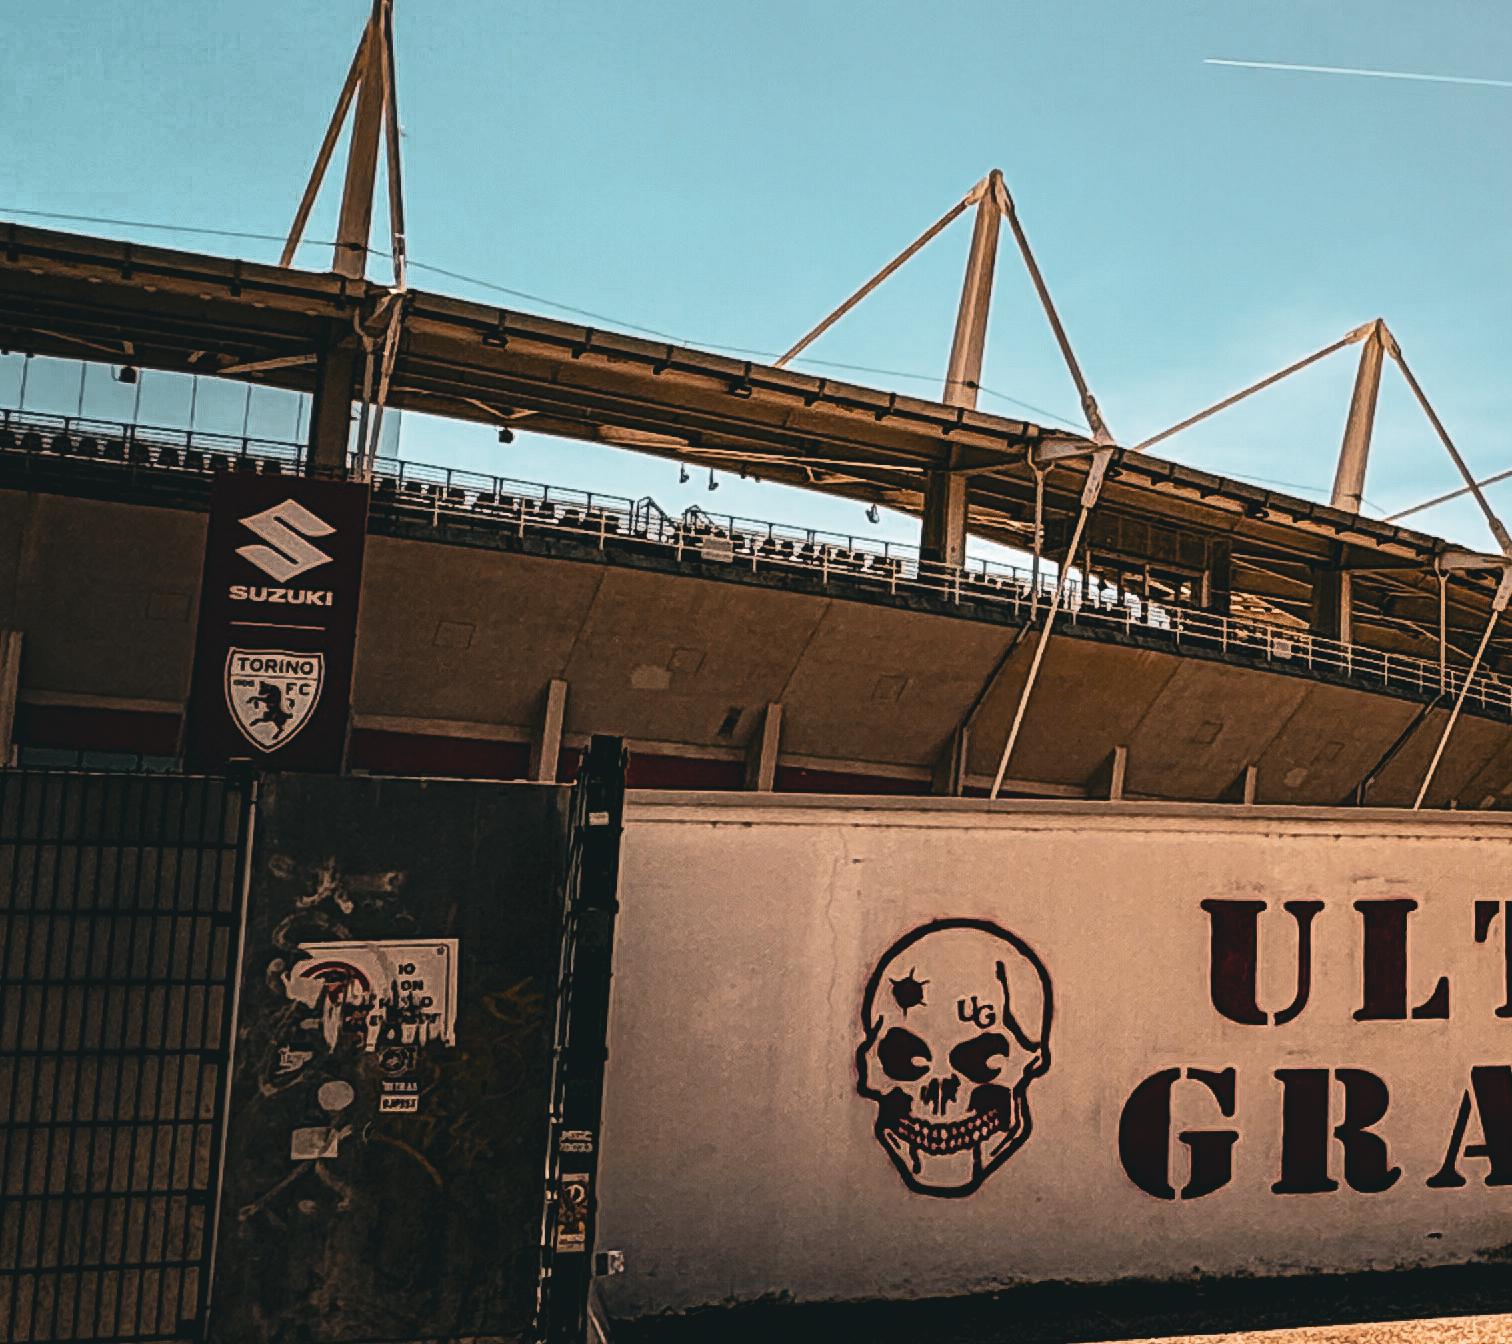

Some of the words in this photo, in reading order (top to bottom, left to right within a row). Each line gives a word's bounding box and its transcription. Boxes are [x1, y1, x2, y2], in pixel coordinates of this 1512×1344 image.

[229, 585, 333, 606] SUZUKI
[237, 657, 314, 675] TORINO
[285, 682, 312, 696] FC
[957, 996, 996, 1029] UG
